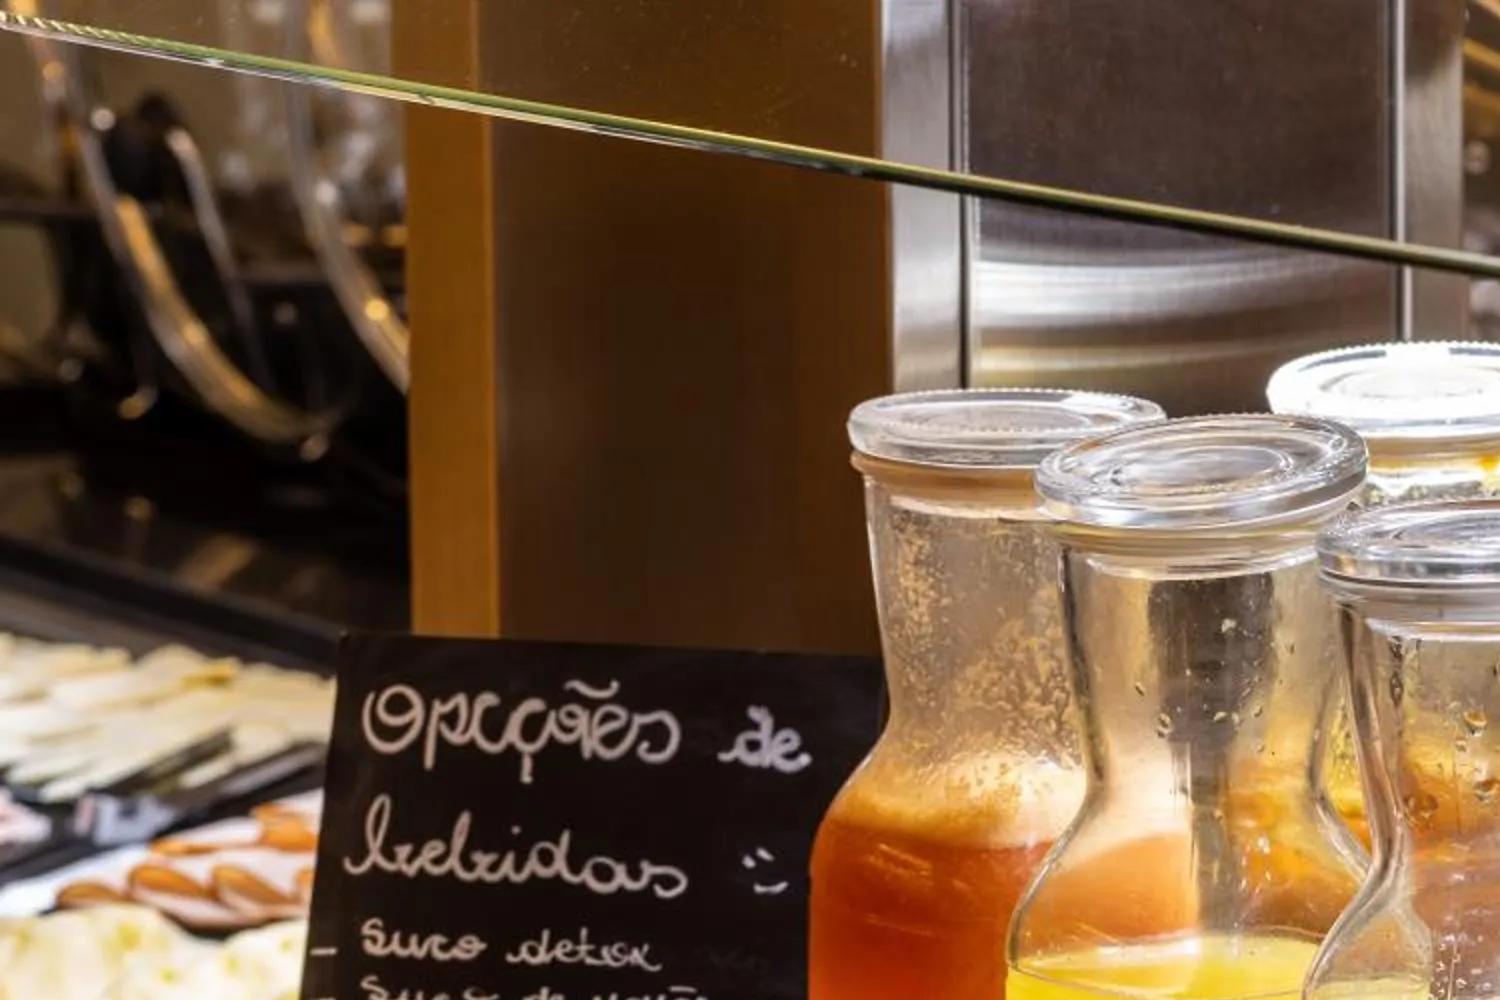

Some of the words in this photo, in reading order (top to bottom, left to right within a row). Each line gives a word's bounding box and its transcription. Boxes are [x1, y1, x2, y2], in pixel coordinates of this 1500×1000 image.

[717, 706, 812, 773] de
[343, 794, 688, 899] bebidas
[505, 927, 662, 972] detox
